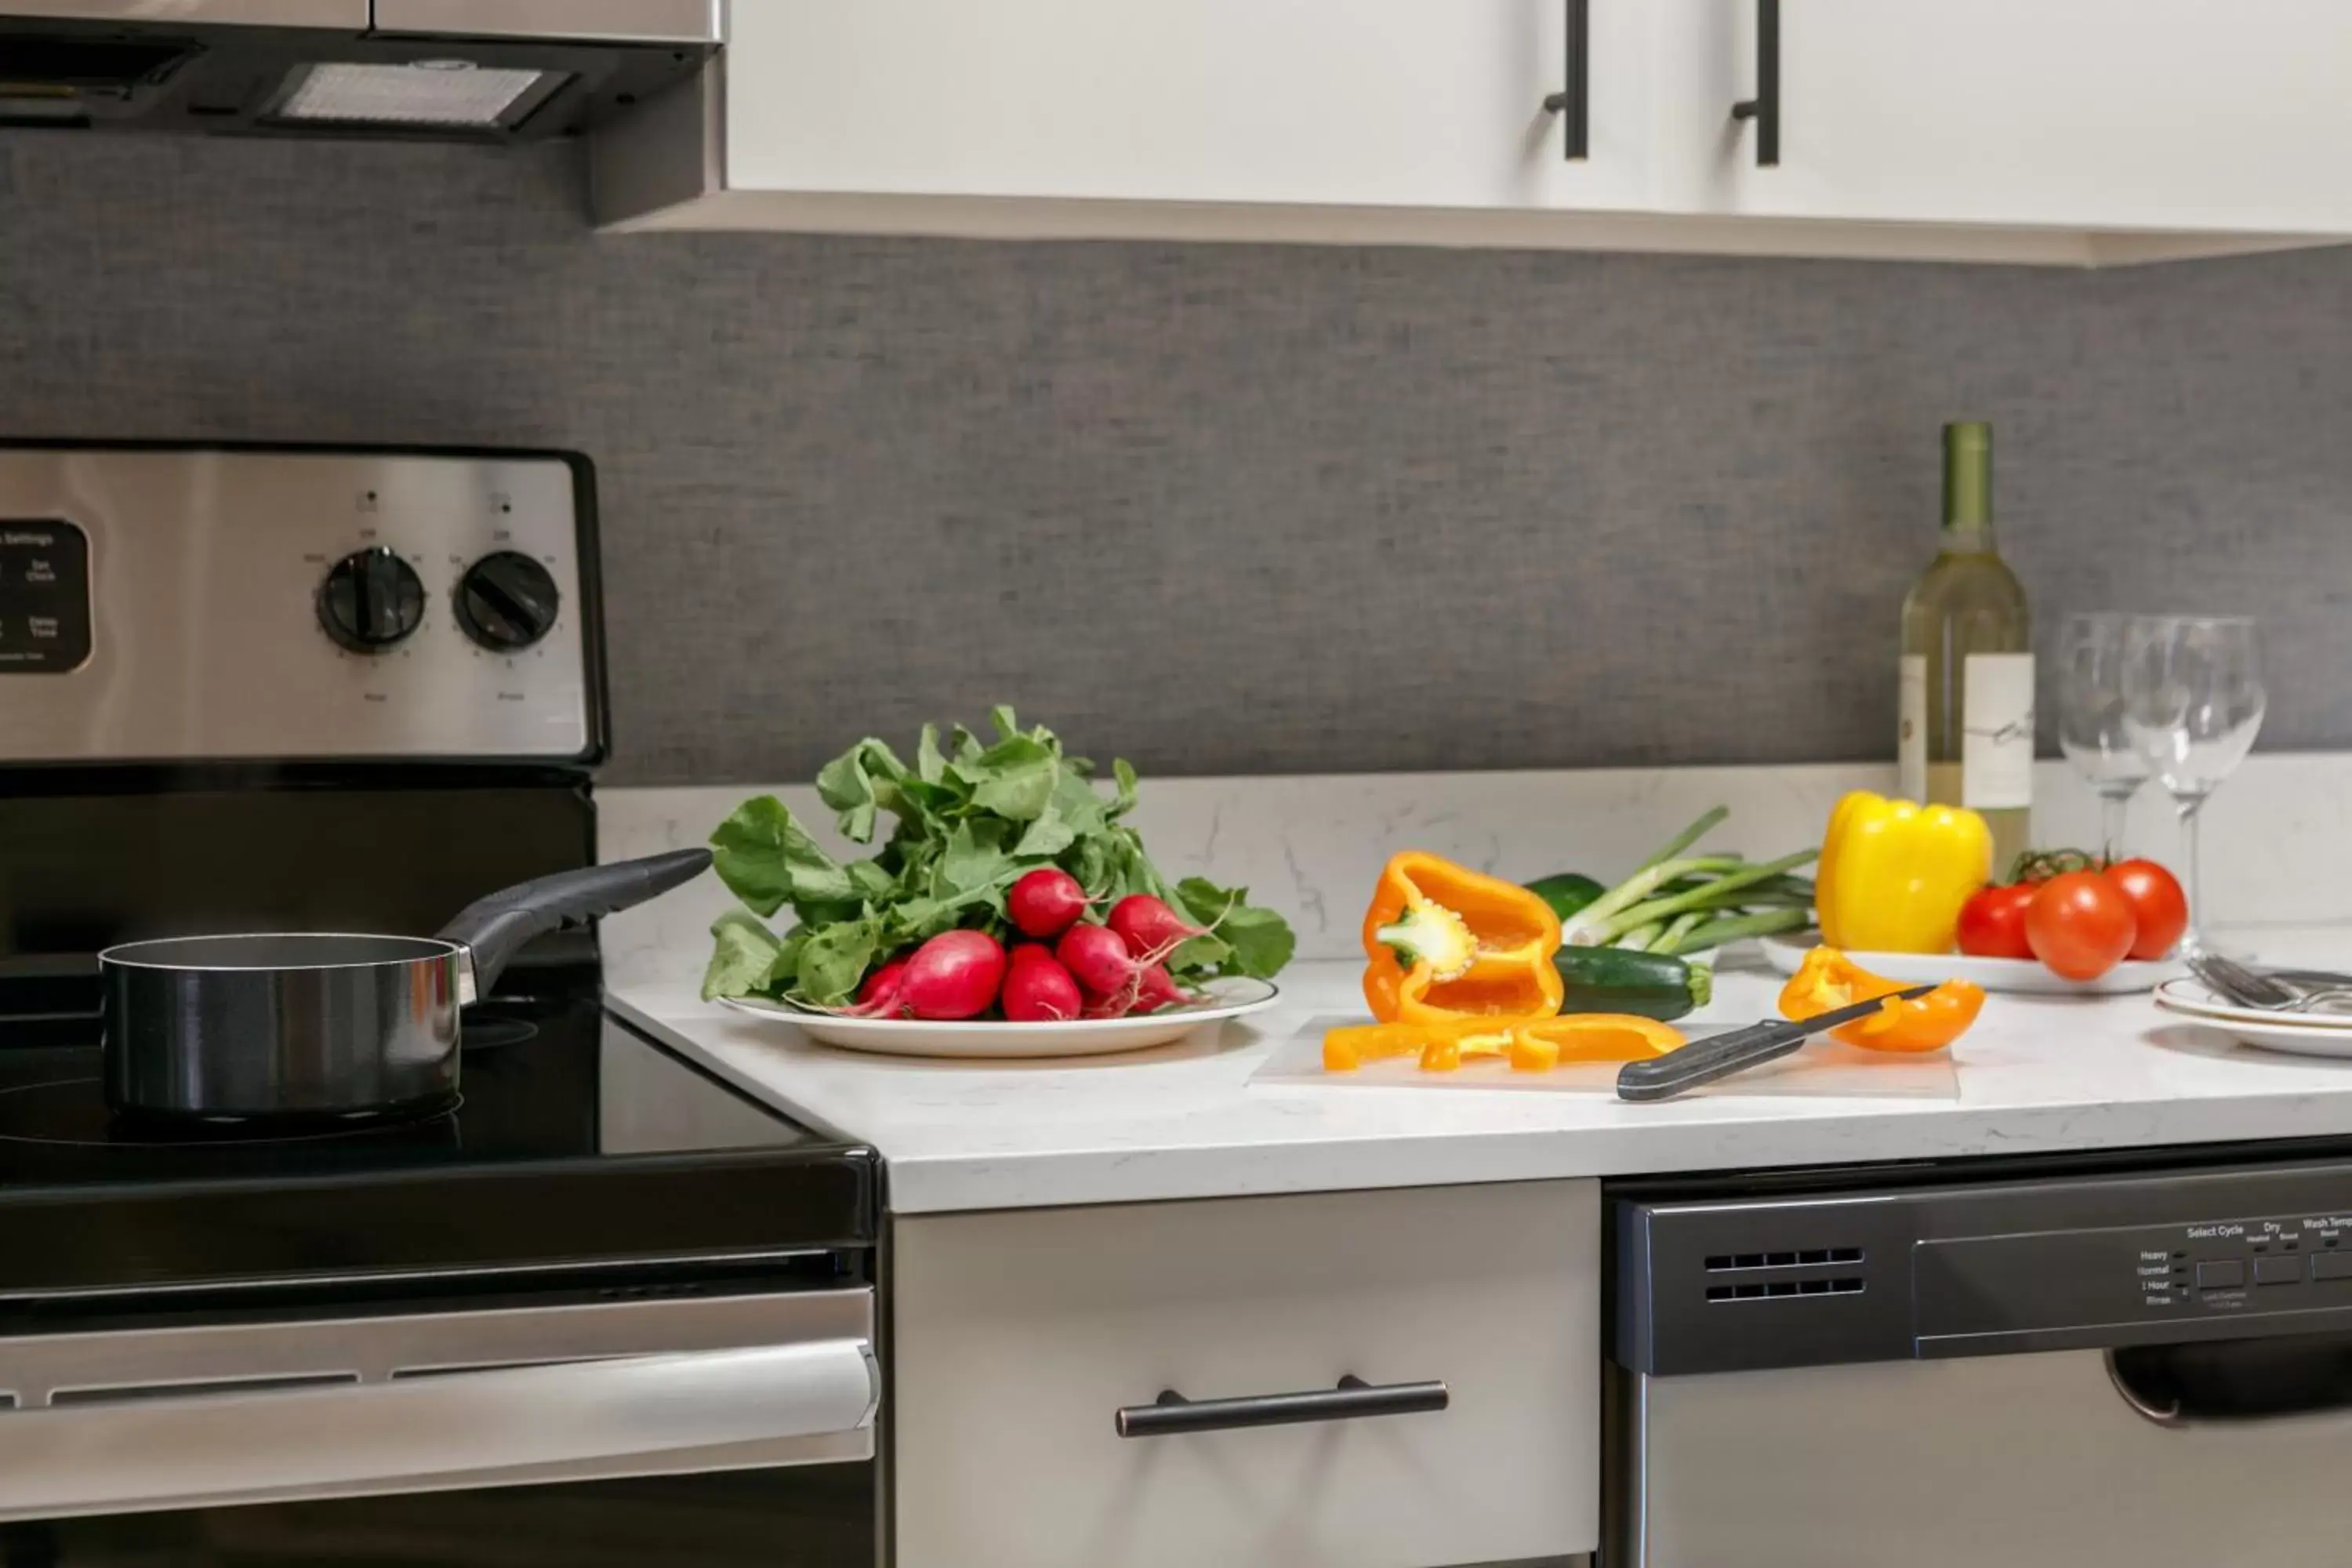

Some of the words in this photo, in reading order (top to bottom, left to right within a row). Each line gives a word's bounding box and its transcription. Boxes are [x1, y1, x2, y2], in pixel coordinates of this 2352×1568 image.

[2263, 1221, 2281, 1234] Dry
[2303, 1218, 2328, 1230] Wash
[2187, 1226, 2216, 1239] Select
[2218, 1224, 2245, 1238] Cycle
[2140, 1250, 2169, 1261] Heavy
[2136, 1265, 2170, 1276] Normal
[2148, 1280, 2170, 1290] Hour
